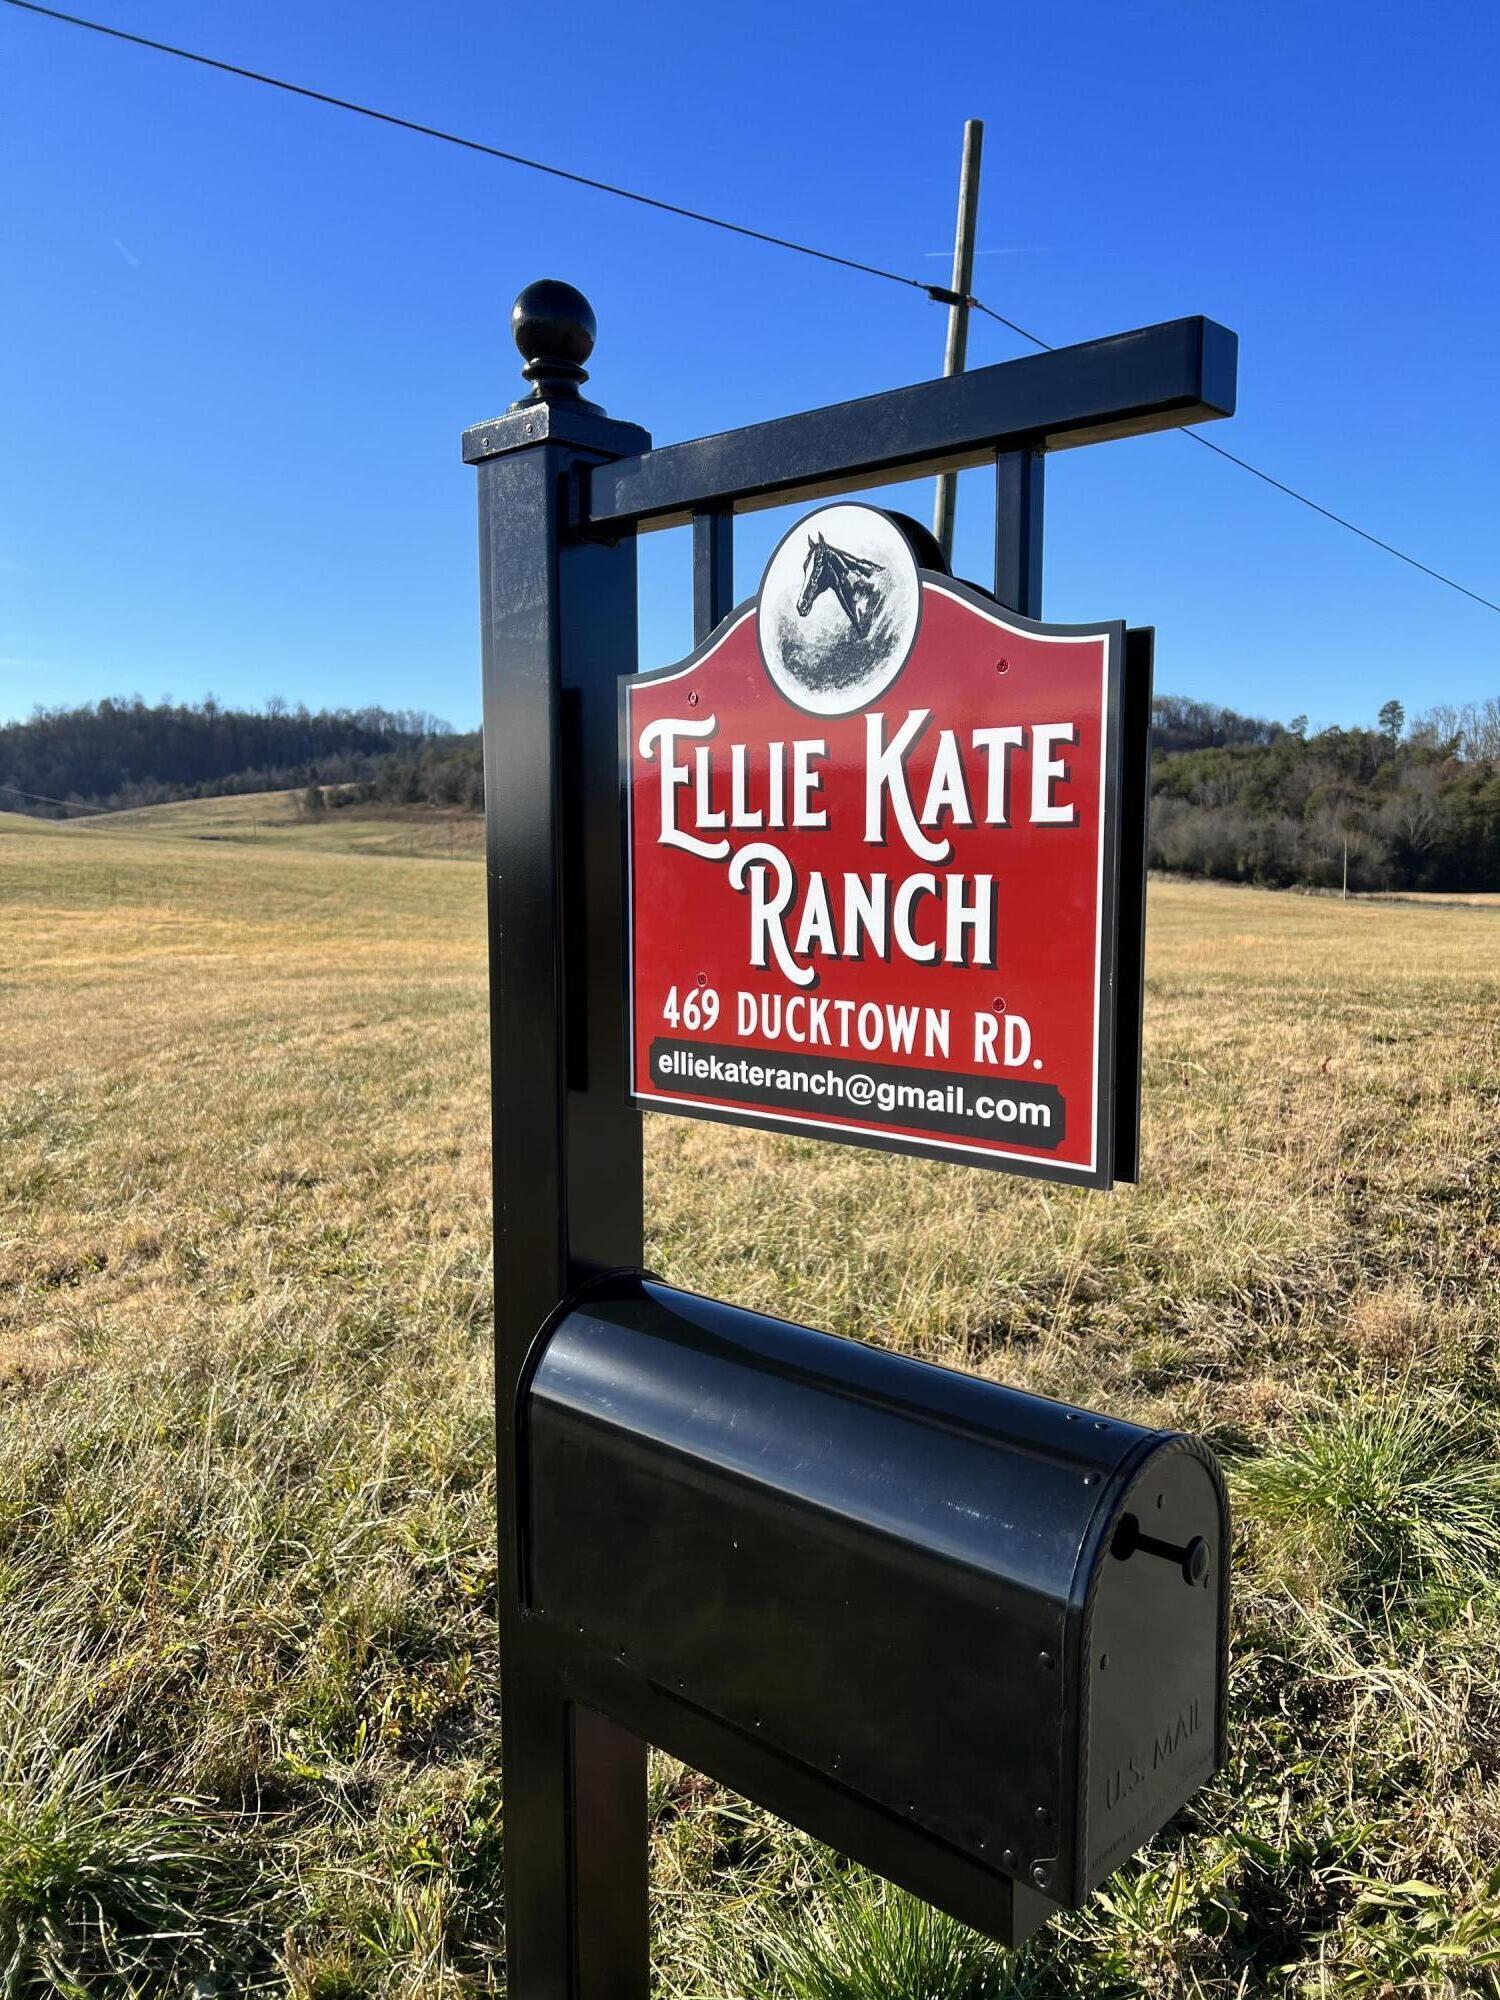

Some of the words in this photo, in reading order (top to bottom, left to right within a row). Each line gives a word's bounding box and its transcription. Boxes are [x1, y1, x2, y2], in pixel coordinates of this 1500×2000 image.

[639, 713, 828, 860] ELLIE
[863, 708, 1075, 863] KATE
[728, 842, 995, 986] RANCH
[662, 985, 720, 1032] 469
[737, 991, 951, 1060] DUCKTOWN
[973, 1011, 1044, 1070] RD.
[657, 1049, 1052, 1127] elliekateranch@gmail.com
[1106, 1754, 1146, 1811] U.S.
[1153, 1698, 1200, 1770] MAIL
